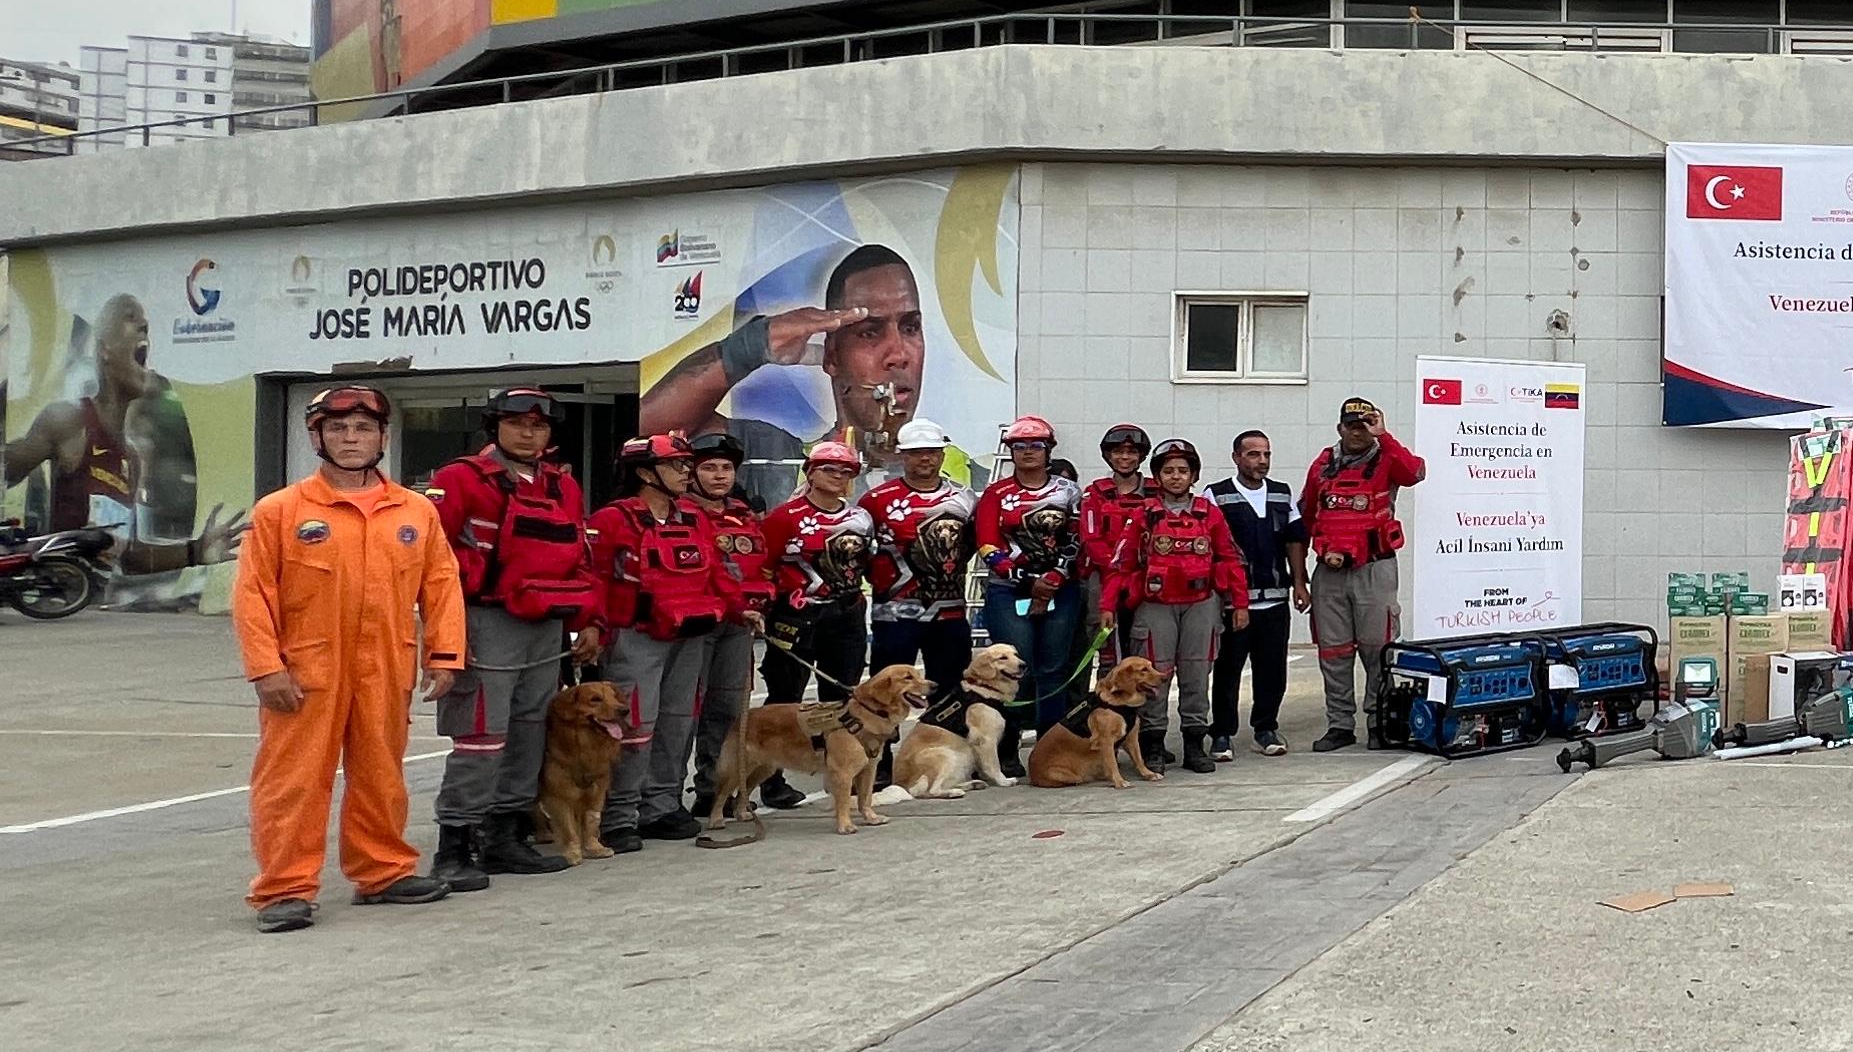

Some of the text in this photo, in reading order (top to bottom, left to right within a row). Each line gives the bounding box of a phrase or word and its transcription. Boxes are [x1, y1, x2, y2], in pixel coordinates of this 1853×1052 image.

[1733, 241, 1836, 261] Asistencia
[348, 258, 546, 298] POLIDEPORTIVO
[308, 292, 592, 340] JOSÉ MARÍA VARGAS
[1456, 421, 1547, 437] Asistencia de
[1450, 443, 1553, 461] Emergencia en
[1467, 464, 1537, 479] Venezuela
[1435, 537, 1463, 554] Acil
[1468, 535, 1512, 553] İnsani
[1483, 588, 1509, 597] FROM
[1464, 597, 1528, 608] THE HEART OF
[1434, 609, 1558, 629] TURKISH PEOPLE
